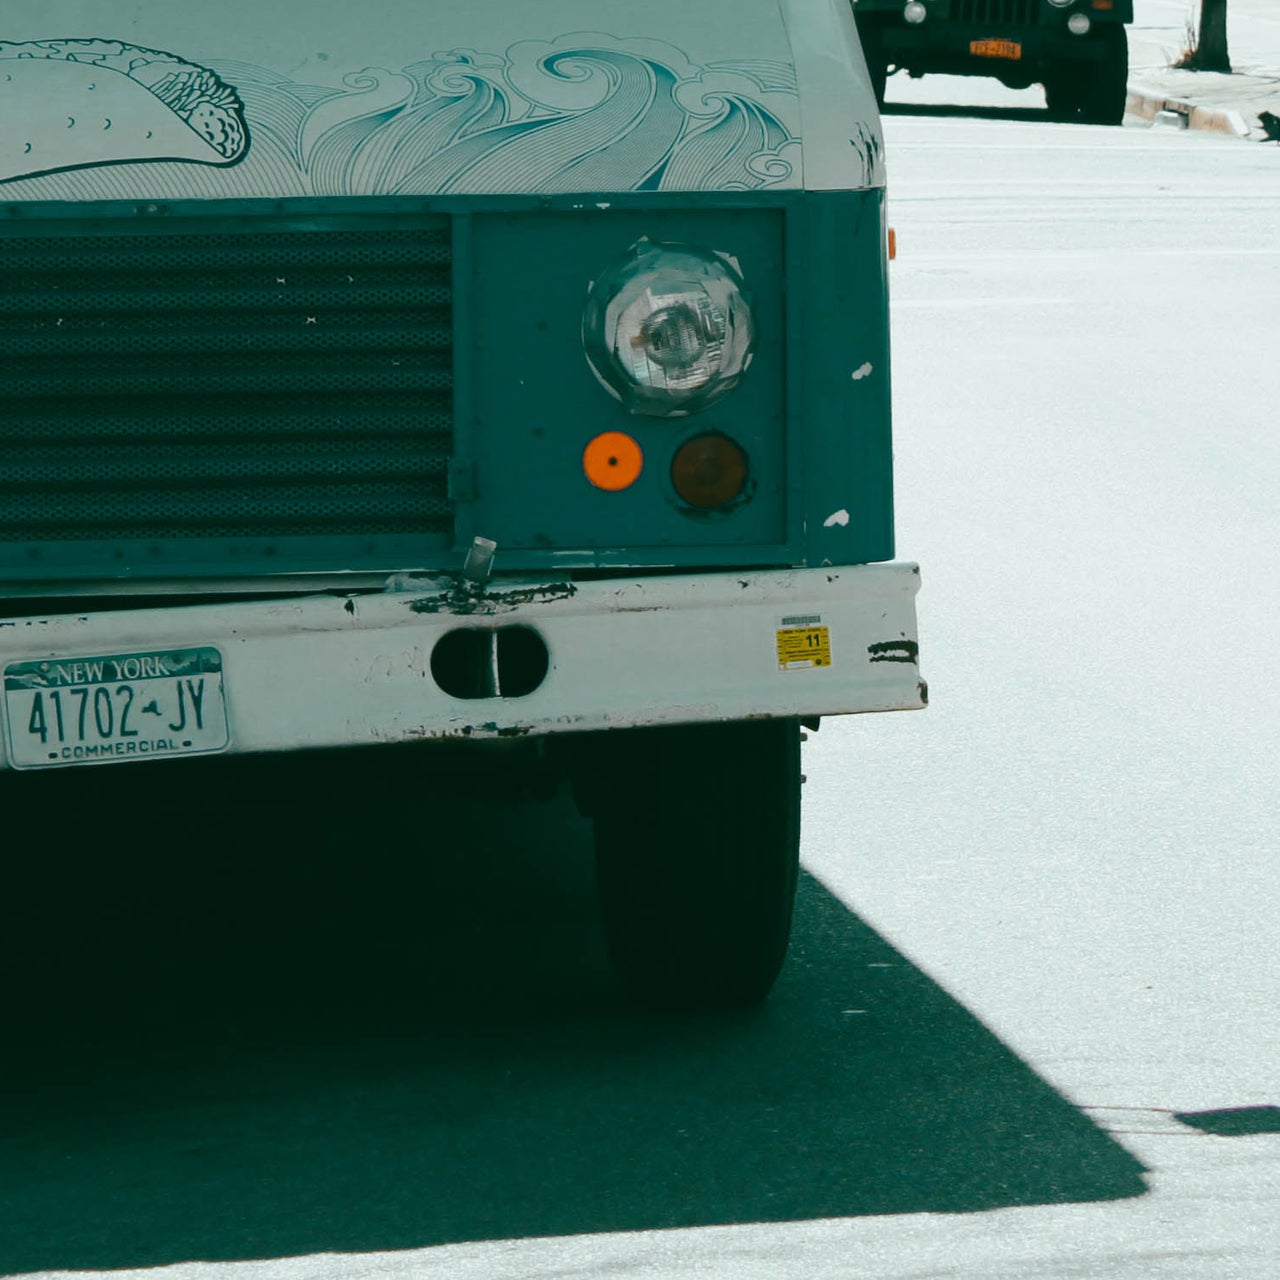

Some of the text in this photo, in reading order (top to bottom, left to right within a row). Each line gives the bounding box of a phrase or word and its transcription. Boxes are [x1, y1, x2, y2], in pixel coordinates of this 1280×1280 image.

[806, 633, 820, 648] 11
[56, 655, 171, 685] NEW YORK
[28, 678, 205, 743] 41702 JY
[61, 738, 178, 759] COMMERCIAL
